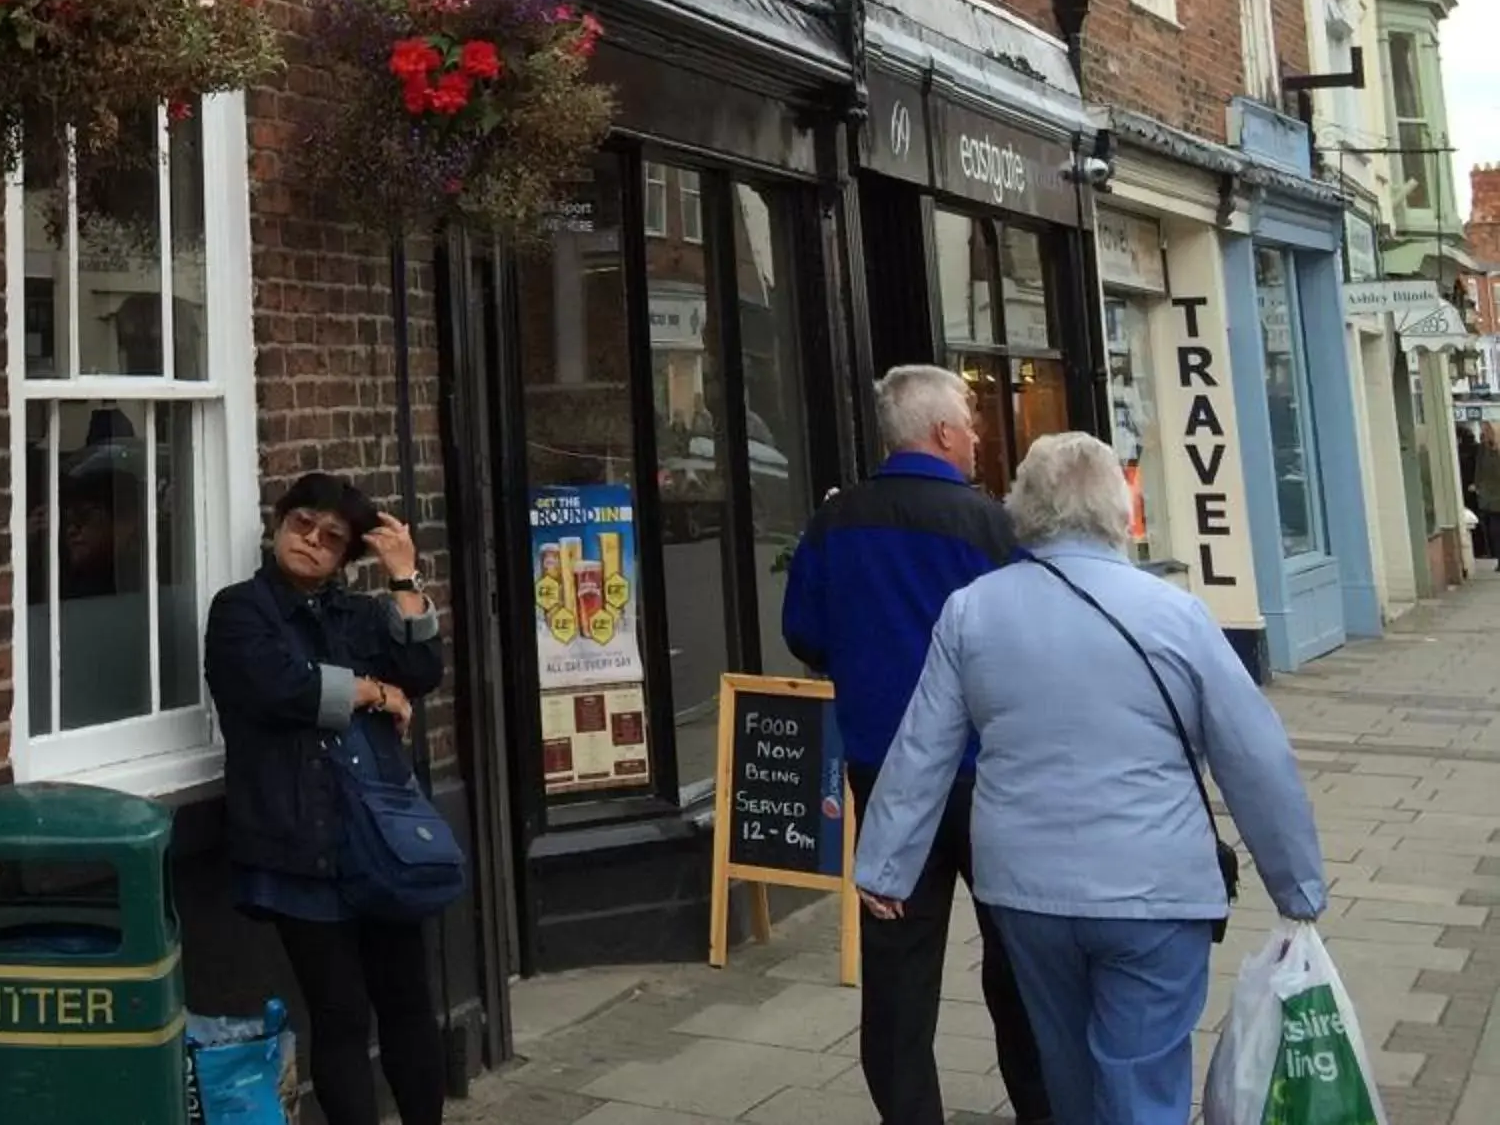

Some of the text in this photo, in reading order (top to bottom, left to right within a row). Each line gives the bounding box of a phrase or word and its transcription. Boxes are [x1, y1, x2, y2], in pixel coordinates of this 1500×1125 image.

[959, 132, 1027, 204] eastgate
[1348, 290, 1435, 305] Ashley Blinds
[1171, 296, 1237, 586] TRAVEL
[558, 495, 581, 509] THE
[745, 712, 799, 736] FOOD
[745, 762, 801, 786] BEING
[736, 791, 808, 818] SERVED
